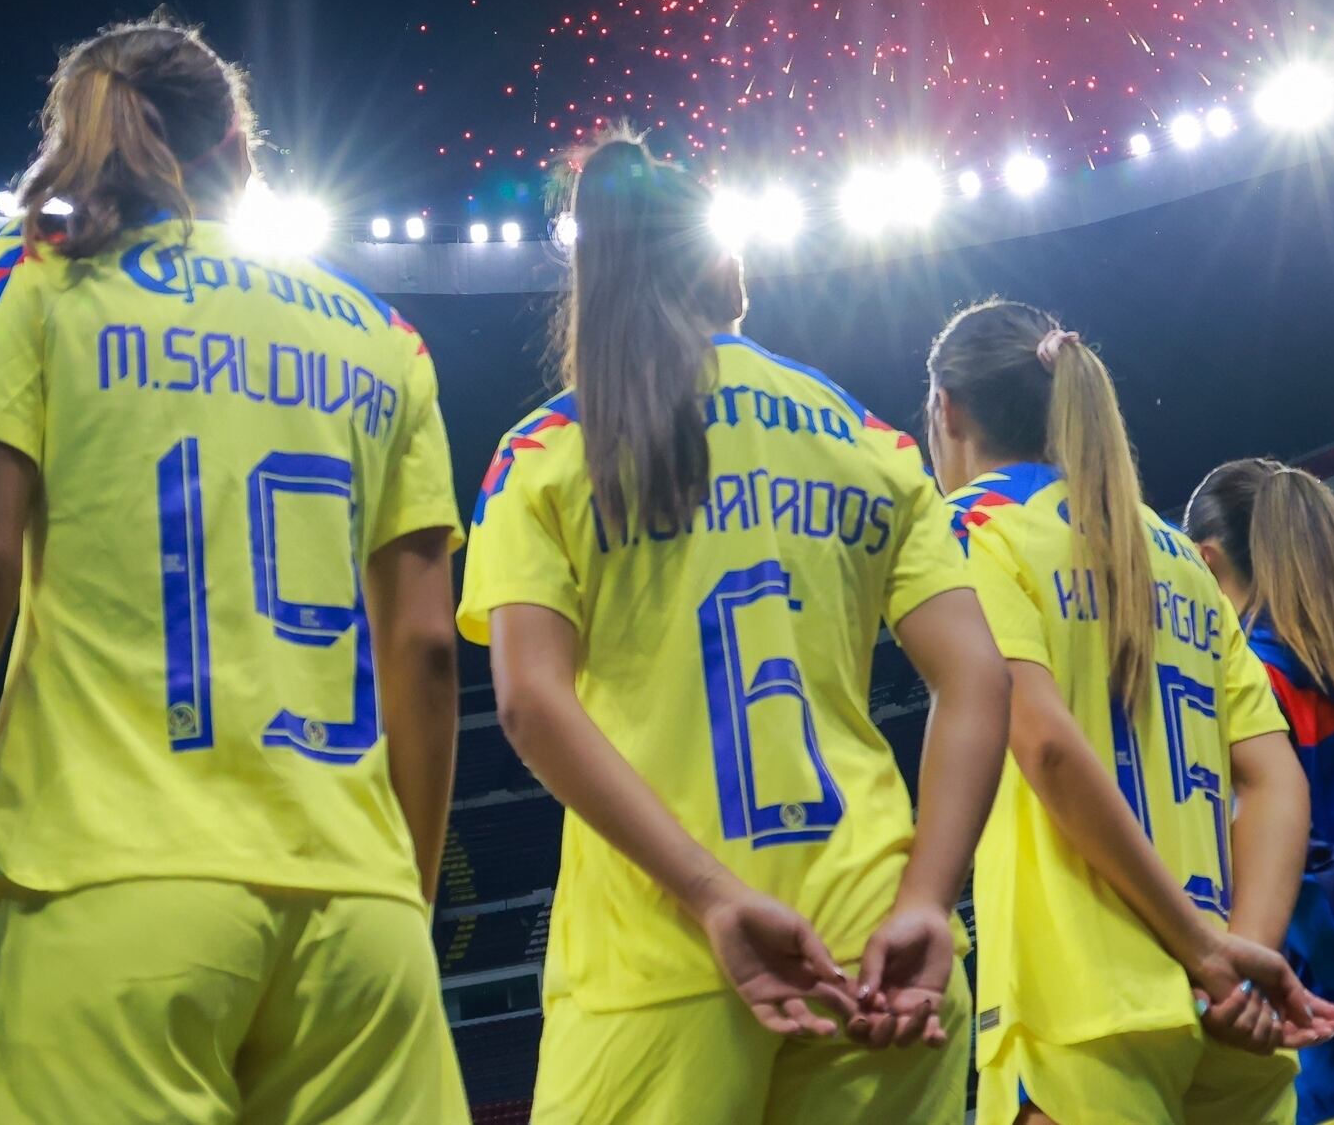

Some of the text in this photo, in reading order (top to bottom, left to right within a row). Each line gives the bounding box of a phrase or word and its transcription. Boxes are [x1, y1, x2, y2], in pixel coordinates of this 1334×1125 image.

[119, 239, 368, 331] Corona
[157, 436, 385, 765] 19
[697, 559, 848, 851] 6
